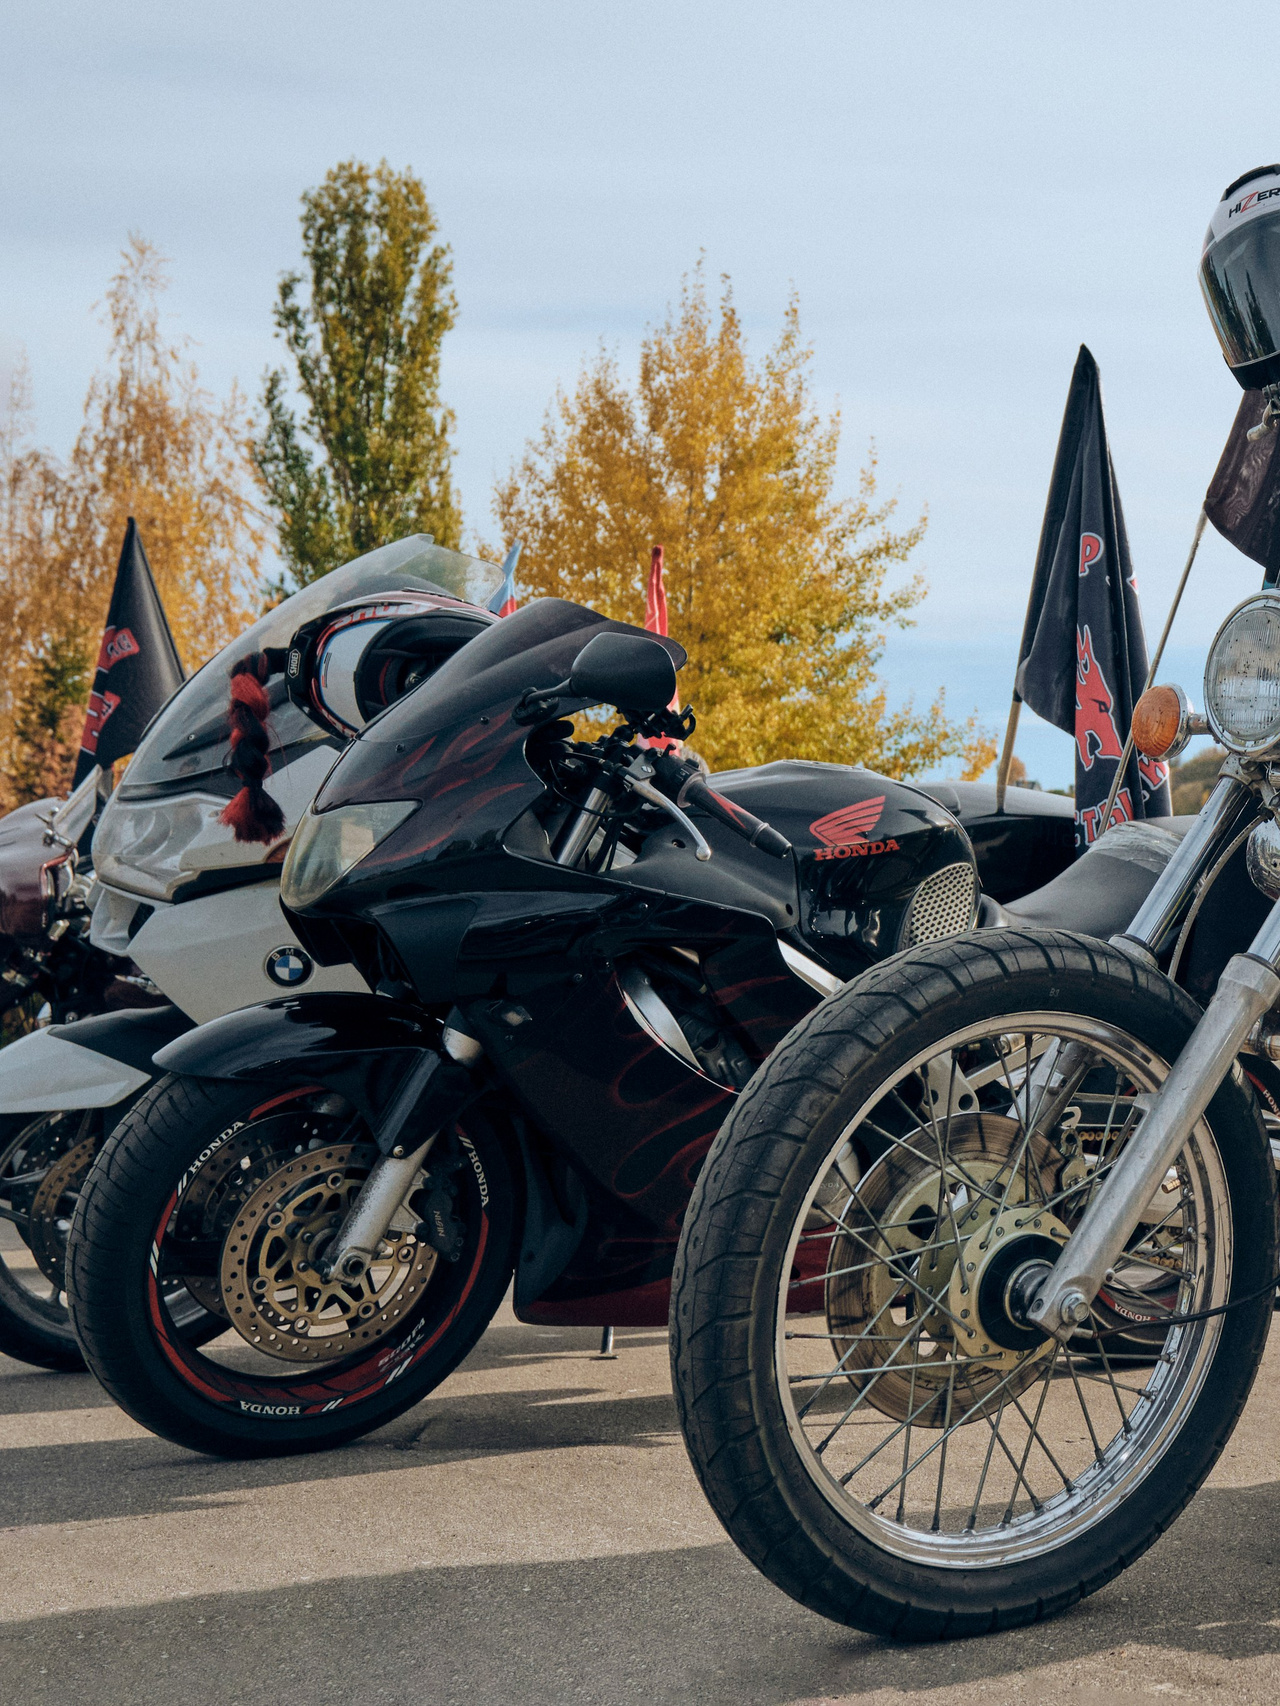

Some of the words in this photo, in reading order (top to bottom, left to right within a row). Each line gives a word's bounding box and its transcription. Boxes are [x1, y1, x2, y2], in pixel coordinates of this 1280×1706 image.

[1229, 187, 1280, 218] HIZER
[288, 652, 299, 675] SHOEI
[813, 839, 900, 861] HONDA
[188, 1121, 245, 1174] HONDA
[468, 1150, 489, 1208] HONDA
[1114, 1303, 1151, 1322] HONDA
[240, 1401, 301, 1416] HONDA
